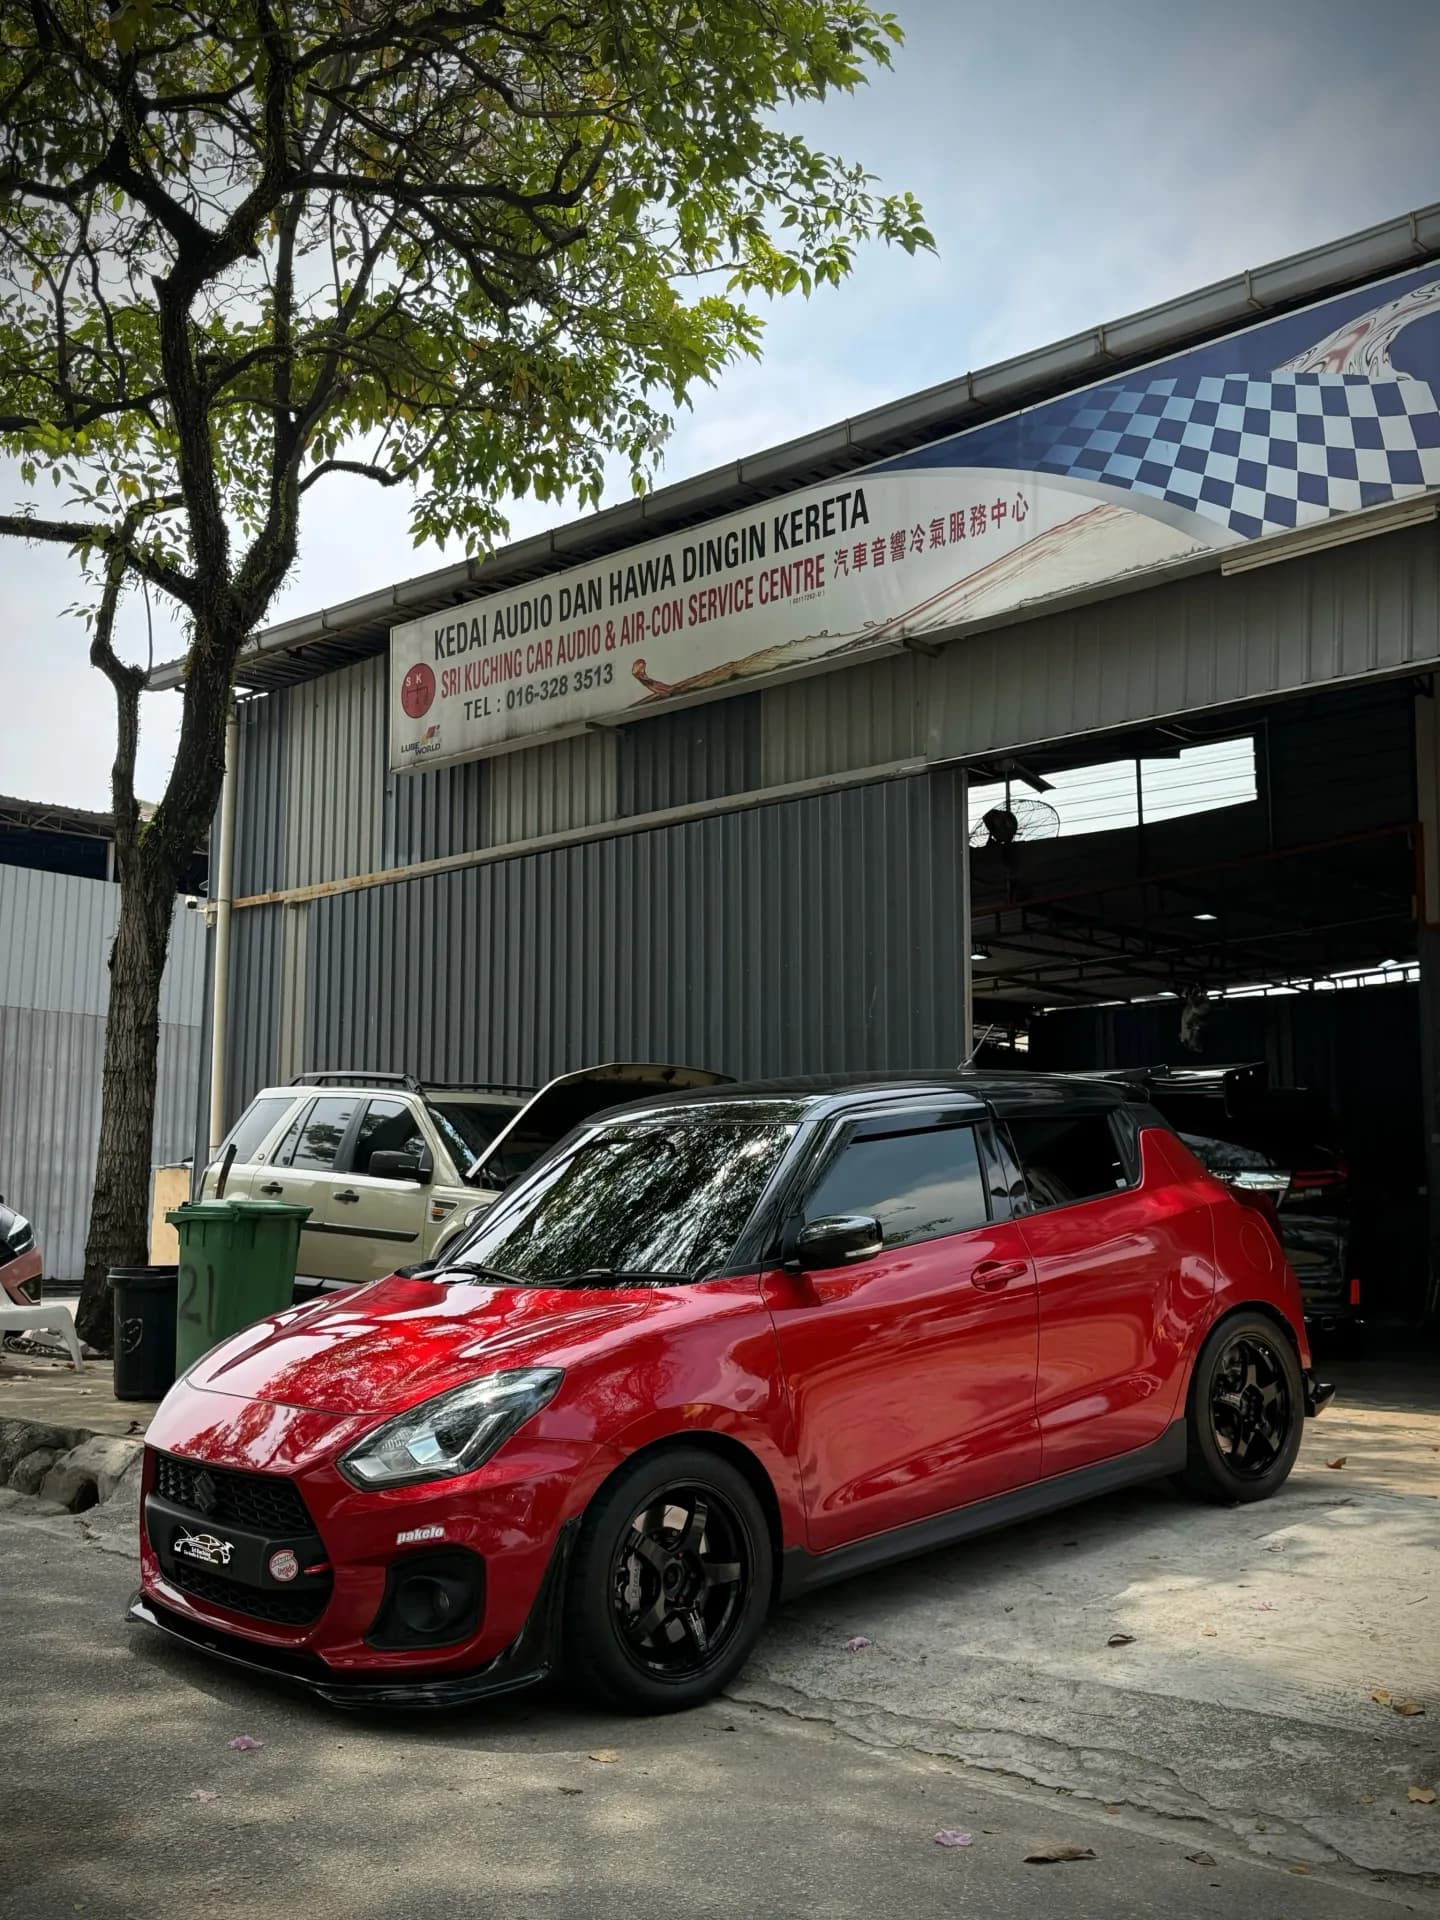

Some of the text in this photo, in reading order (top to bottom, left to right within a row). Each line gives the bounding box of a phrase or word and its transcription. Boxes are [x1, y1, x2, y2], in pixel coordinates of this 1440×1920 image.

[833, 491, 1030, 579] 汽車音響冷氣服務中心
[434, 488, 869, 661] KEDAI AUDIO DAN HAWA DINGIN KERETA
[441, 553, 825, 698] SRI KUCHING CAR AUDIO & AIR-CON SERVICE CENTRE
[405, 672, 422, 687] S K
[464, 696, 491, 721] TEL
[506, 674, 568, 710] 016-328
[573, 663, 613, 692] 3513
[415, 743, 441, 756] WORLD
[396, 1526, 445, 1546] pakelo
